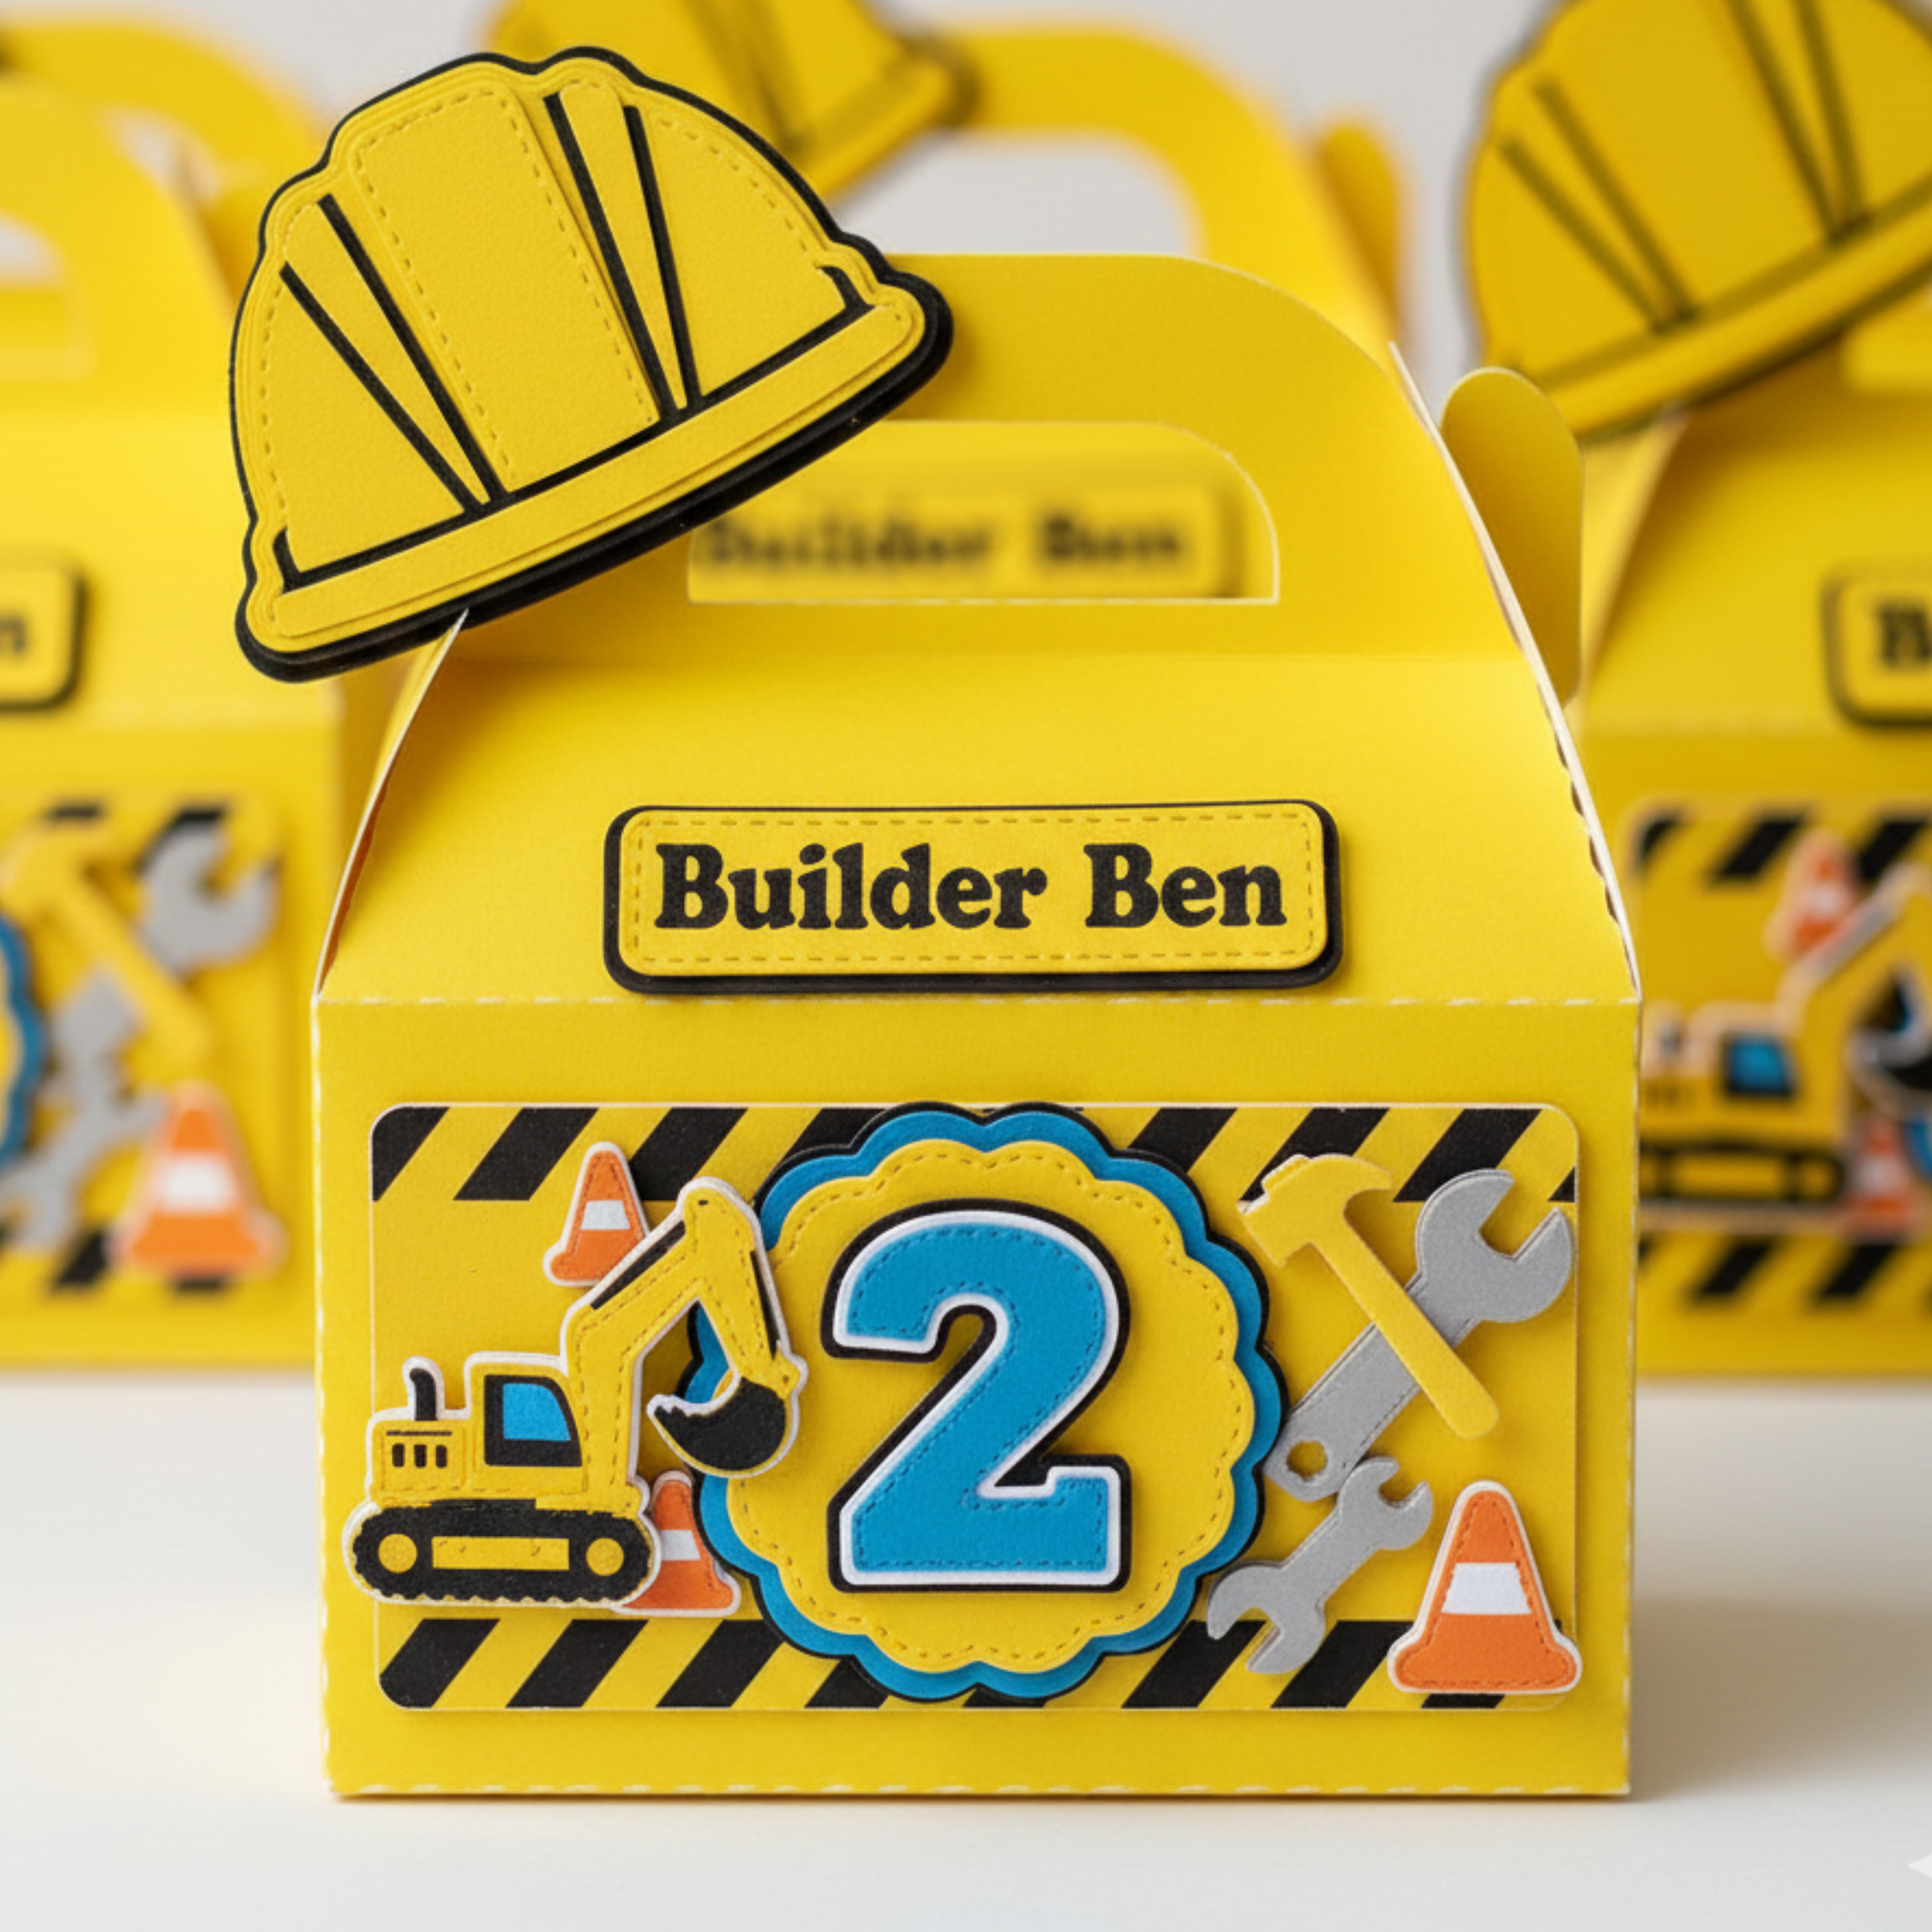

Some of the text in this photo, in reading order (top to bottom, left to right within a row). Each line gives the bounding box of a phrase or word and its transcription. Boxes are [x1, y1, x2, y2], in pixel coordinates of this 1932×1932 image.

[654, 842, 1287, 930] Builder Ben
[821, 1198, 1132, 1593] 2
